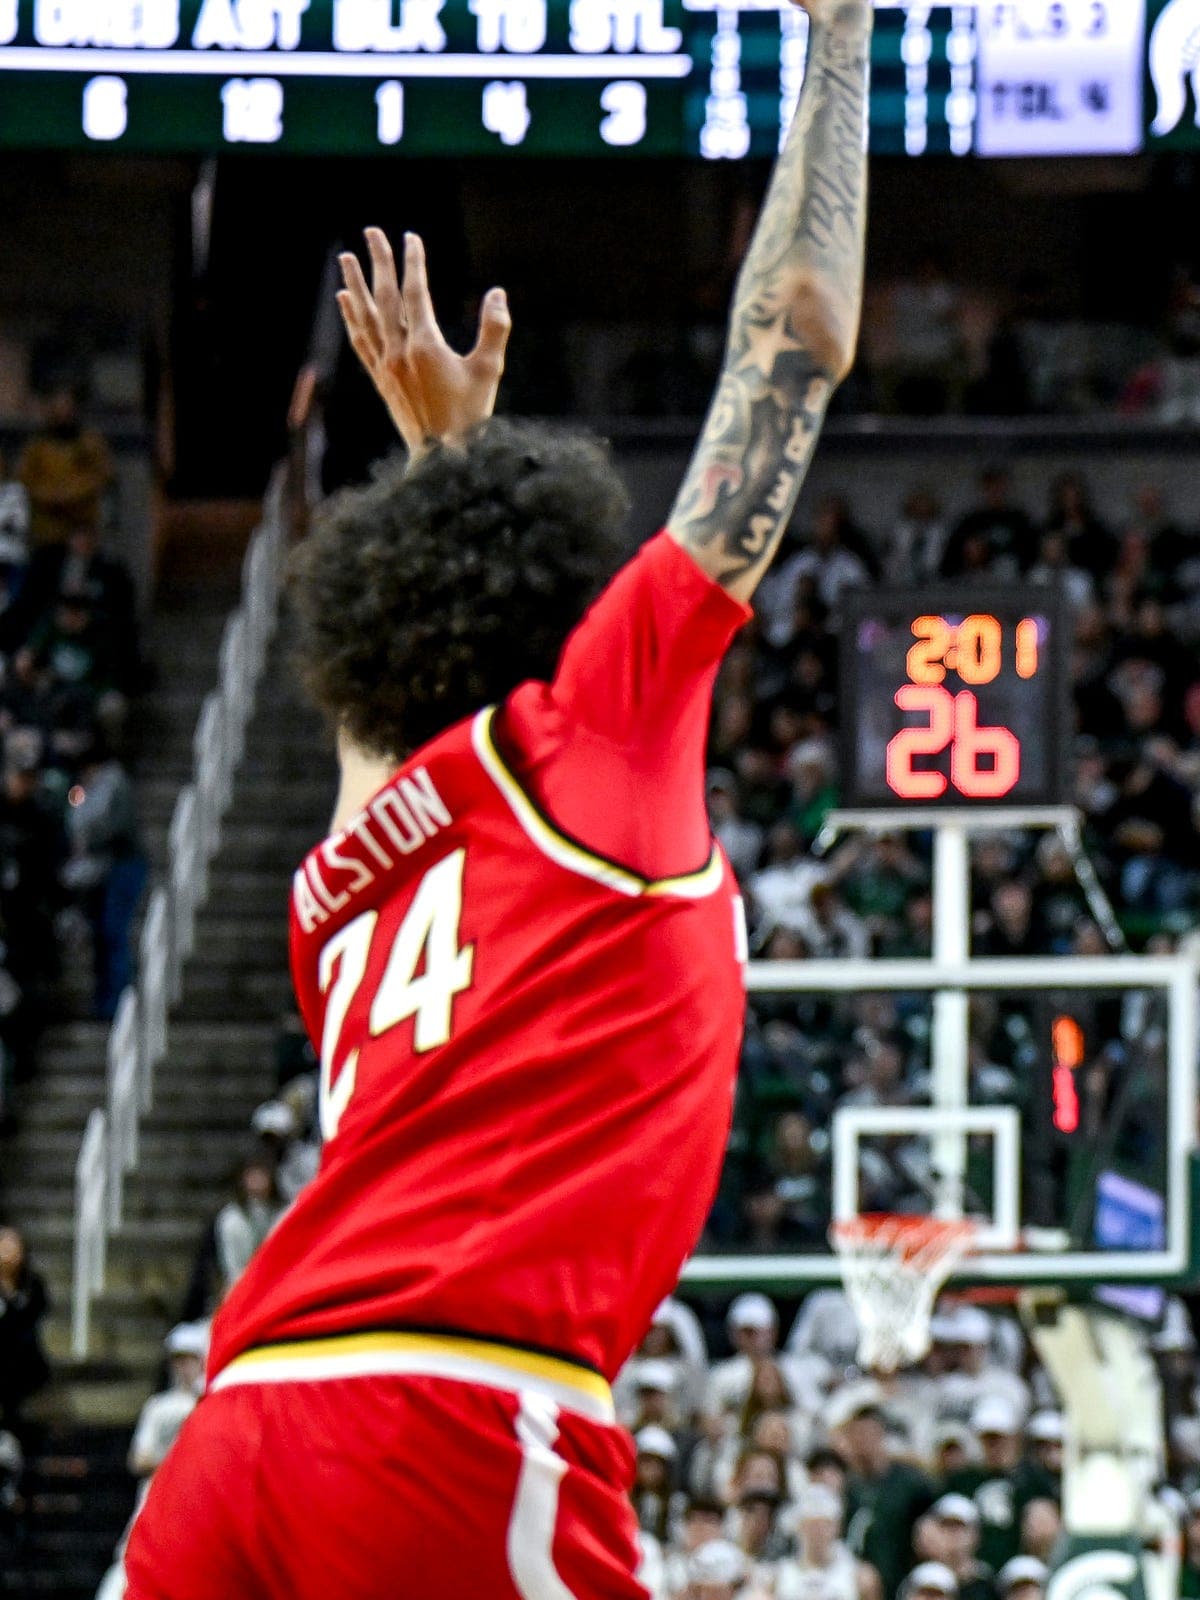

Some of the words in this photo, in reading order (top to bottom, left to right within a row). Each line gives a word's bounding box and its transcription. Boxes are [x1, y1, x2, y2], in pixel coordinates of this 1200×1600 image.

[191, 0, 311, 50] AST
[332, 0, 449, 52] BLK
[468, 0, 546, 53] TO
[568, 0, 684, 53] STL
[375, 79, 404, 145] 1
[481, 80, 531, 146] 4
[600, 80, 647, 146] 3
[905, 614, 1039, 686] 2:01
[885, 682, 1021, 799] 26
[292, 765, 453, 935] ALSTON
[318, 846, 475, 1142] 24
